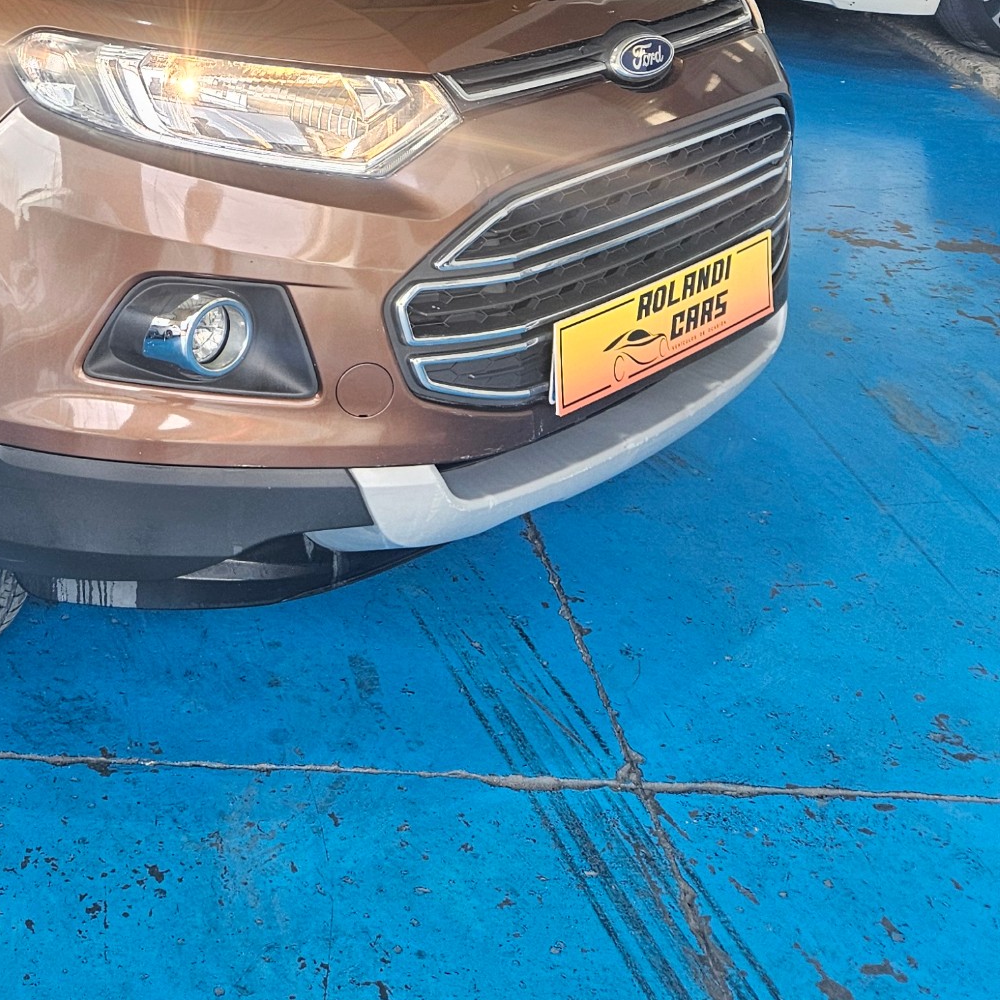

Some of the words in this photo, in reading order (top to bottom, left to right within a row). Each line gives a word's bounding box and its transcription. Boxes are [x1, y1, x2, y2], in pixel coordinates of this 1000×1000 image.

[632, 42, 664, 70] Ford
[636, 254, 732, 321] ROLANDI
[670, 289, 728, 341] CARS
